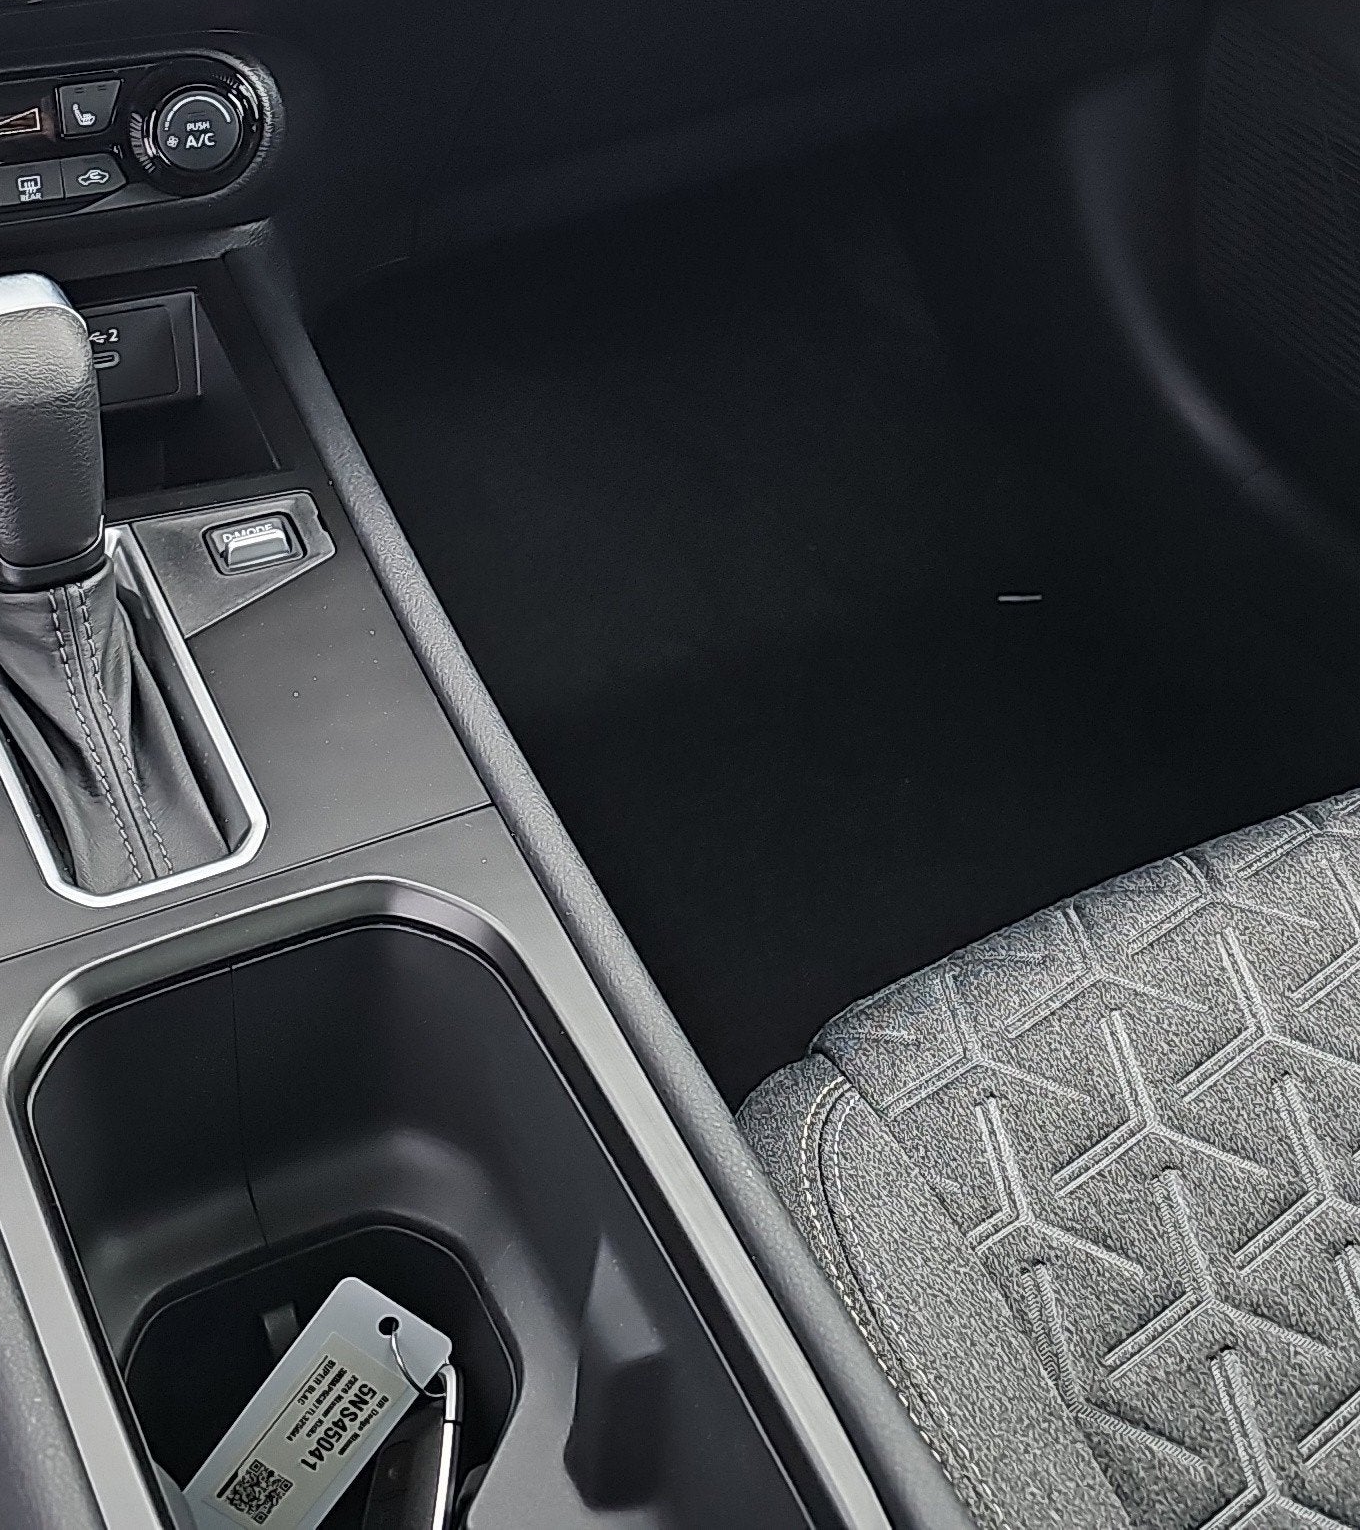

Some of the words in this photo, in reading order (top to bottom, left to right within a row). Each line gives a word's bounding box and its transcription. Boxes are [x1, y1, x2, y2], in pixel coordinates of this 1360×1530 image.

[186, 121, 210, 132] PUSH
[185, 133, 215, 149] A/C
[20, 193, 42, 202] REAR
[109, 329, 119, 341] 2
[297, 1385, 317, 1406] BLAC
[301, 1384, 378, 1471] 5NS45041
